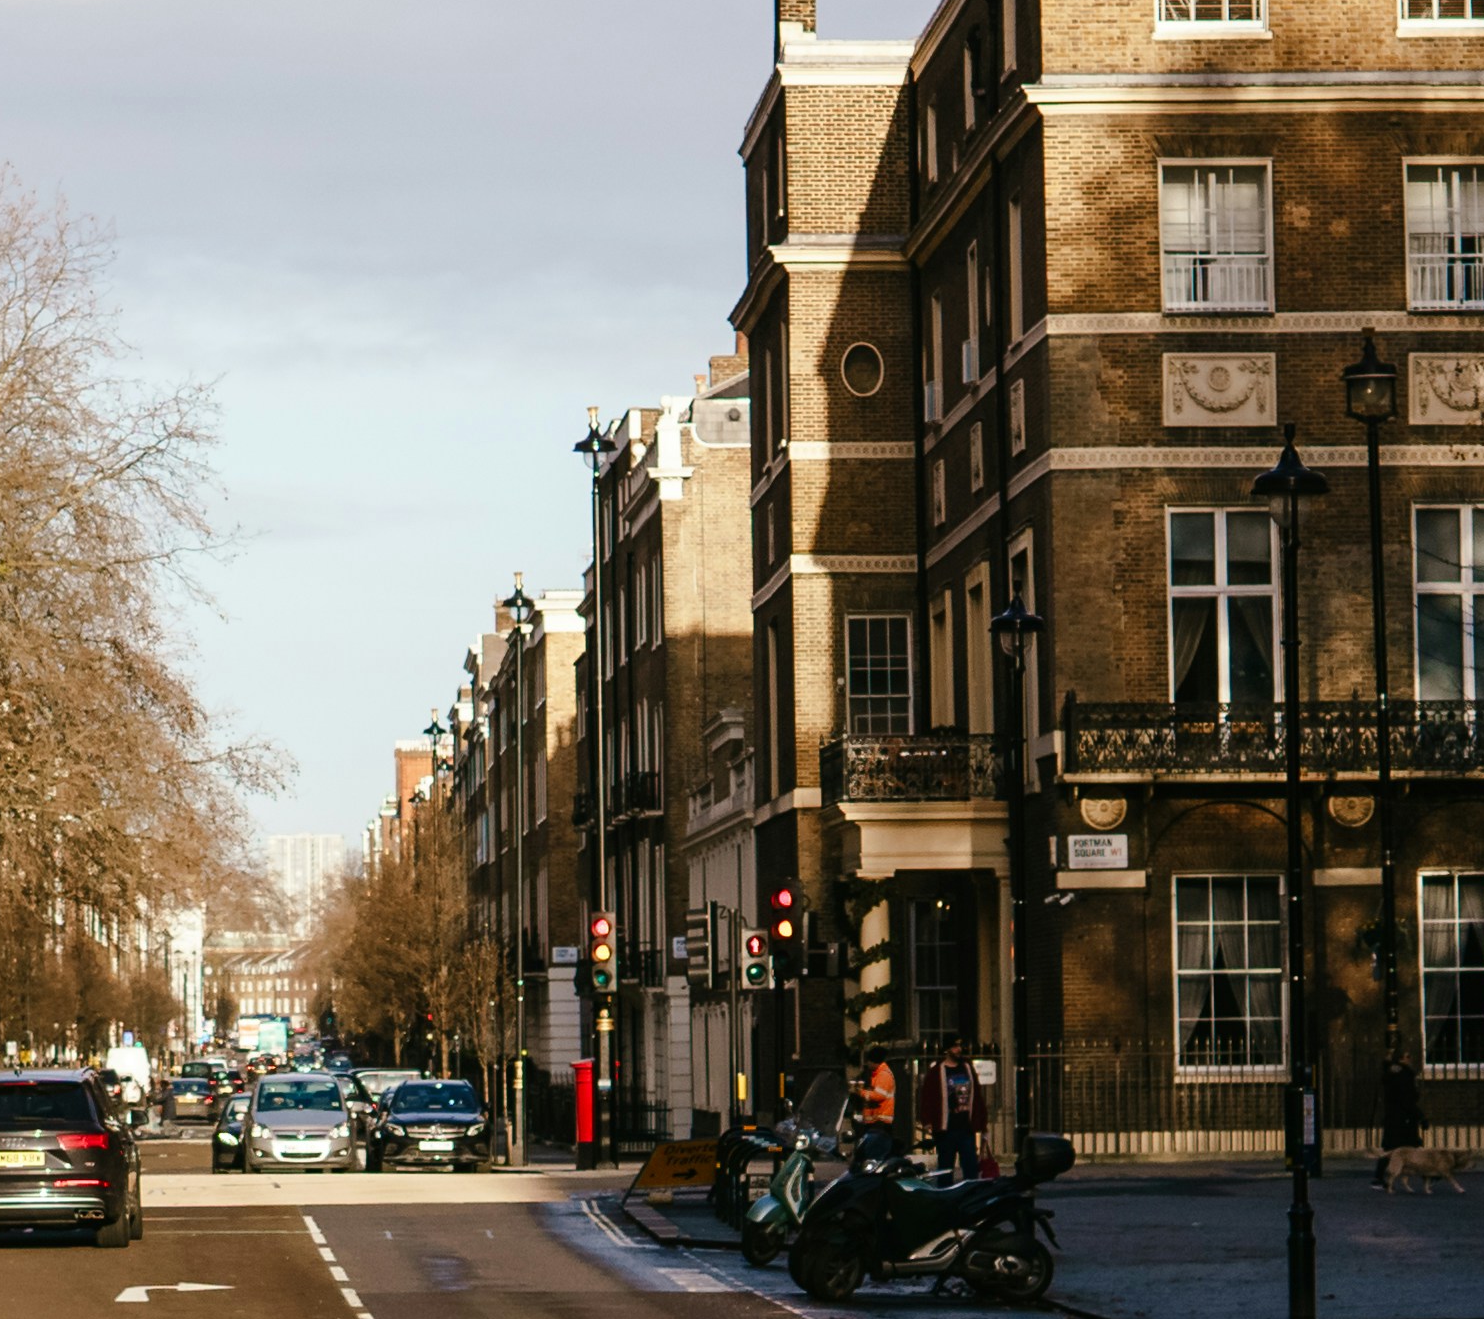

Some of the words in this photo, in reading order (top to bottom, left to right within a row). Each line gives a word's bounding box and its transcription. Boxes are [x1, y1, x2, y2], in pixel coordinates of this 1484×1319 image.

[1074, 839, 1112, 847] PORTMAN
[1075, 849, 1105, 857] SQUARE
[667, 1154, 713, 1165] Traffic
